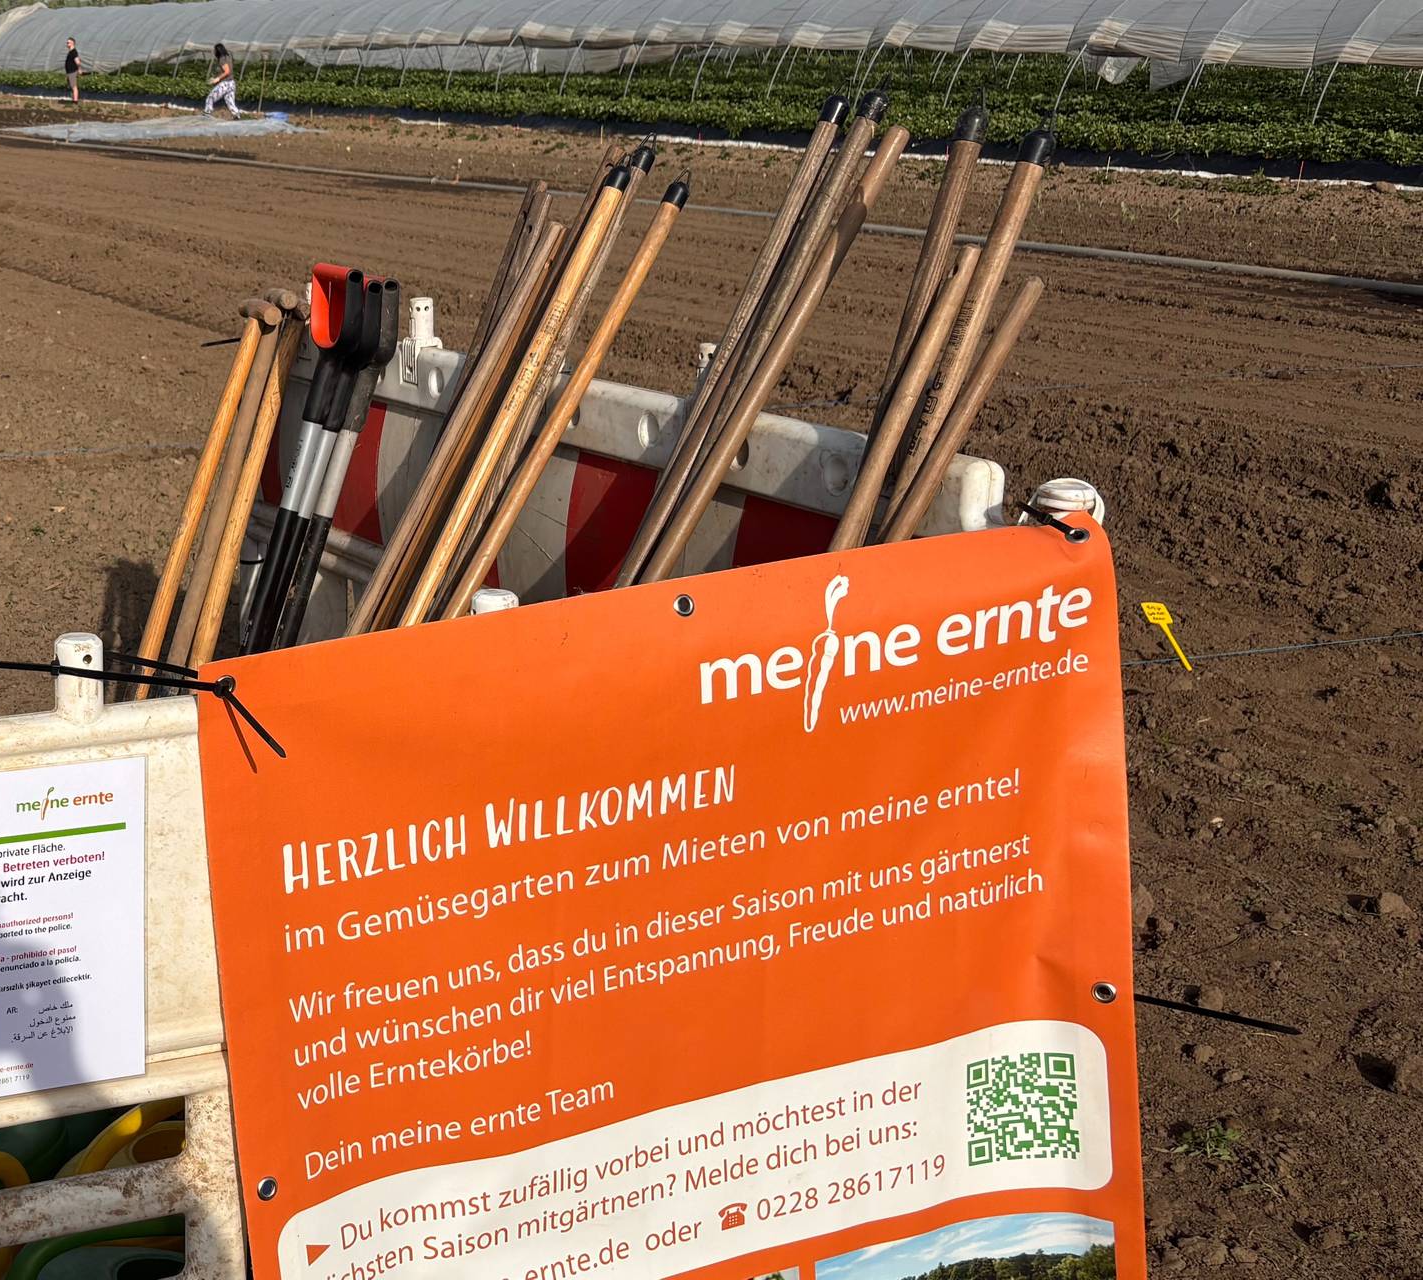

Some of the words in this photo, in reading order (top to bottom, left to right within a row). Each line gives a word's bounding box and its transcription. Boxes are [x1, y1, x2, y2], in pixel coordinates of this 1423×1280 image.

[936, 585, 1092, 656] ernte
[839, 649, 1089, 724] www.meine-ernte.de
[72, 792, 114, 806] ernte
[282, 814, 466, 894] HERZLICH
[485, 764, 734, 848] WILLKOMMEN
[0, 875, 24, 888] wird
[27, 875, 45, 884] zur
[47, 869, 91, 882] Anzeige
[2, 859, 49, 872] Betreten
[52, 850, 104, 866] verboten!
[32, 842, 65, 854] Fläche.
[284, 924, 324, 952] im
[337, 870, 573, 940] Gemüsegarten
[584, 854, 649, 885] zum
[662, 829, 765, 869] Mieten
[776, 816, 829, 844] von
[840, 795, 928, 831] meine
[937, 767, 1019, 808] ernte!
[34, 926, 47, 934] the
[48, 923, 73, 933] police.
[42, 912, 74, 924] persons!
[288, 990, 335, 1022] Wir
[343, 975, 438, 1009] freuen
[448, 960, 500, 989] uns,
[507, 941, 564, 973] dass
[572, 928, 606, 956] du
[615, 922, 638, 946] in
[646, 904, 724, 938] dieser
[732, 886, 813, 919] Saison
[822, 870, 862, 900] mit
[869, 862, 913, 888] uns
[920, 833, 1030, 884] gärtnerst
[294, 1026, 346, 1066] und
[355, 1002, 501, 1048] wünschen
[509, 986, 544, 1016] dir
[550, 969, 594, 1004] viel
[603, 934, 780, 991] Entspannung,
[789, 907, 873, 947] Freude
[882, 892, 930, 926] und
[939, 868, 1043, 914] natürlich
[296, 1070, 360, 1109] volle
[369, 1029, 531, 1088] Erntekörbe!
[304, 1140, 362, 1180] Dein
[371, 1119, 461, 1154] meine
[470, 1102, 541, 1135] ernte
[545, 1081, 613, 1115] Team
[340, 1219, 372, 1250] Du
[379, 1191, 490, 1232] kommst
[498, 1167, 587, 1208] zufällig
[594, 1136, 669, 1179] vorbei
[677, 1121, 724, 1155] und
[732, 1096, 846, 1142] möchtest
[853, 1091, 873, 1112] in
[881, 1080, 921, 1105] der
[423, 1225, 509, 1260] Saison
[517, 1173, 676, 1239] mitgärtnern?
[685, 1159, 758, 1192] Melde
[766, 1139, 817, 1170] dich
[826, 1127, 860, 1157] bei
[868, 1120, 918, 1145] uns:
[645, 1219, 702, 1252] oder
[756, 1187, 818, 1220] 0228
[827, 1154, 945, 1204] 28617119
